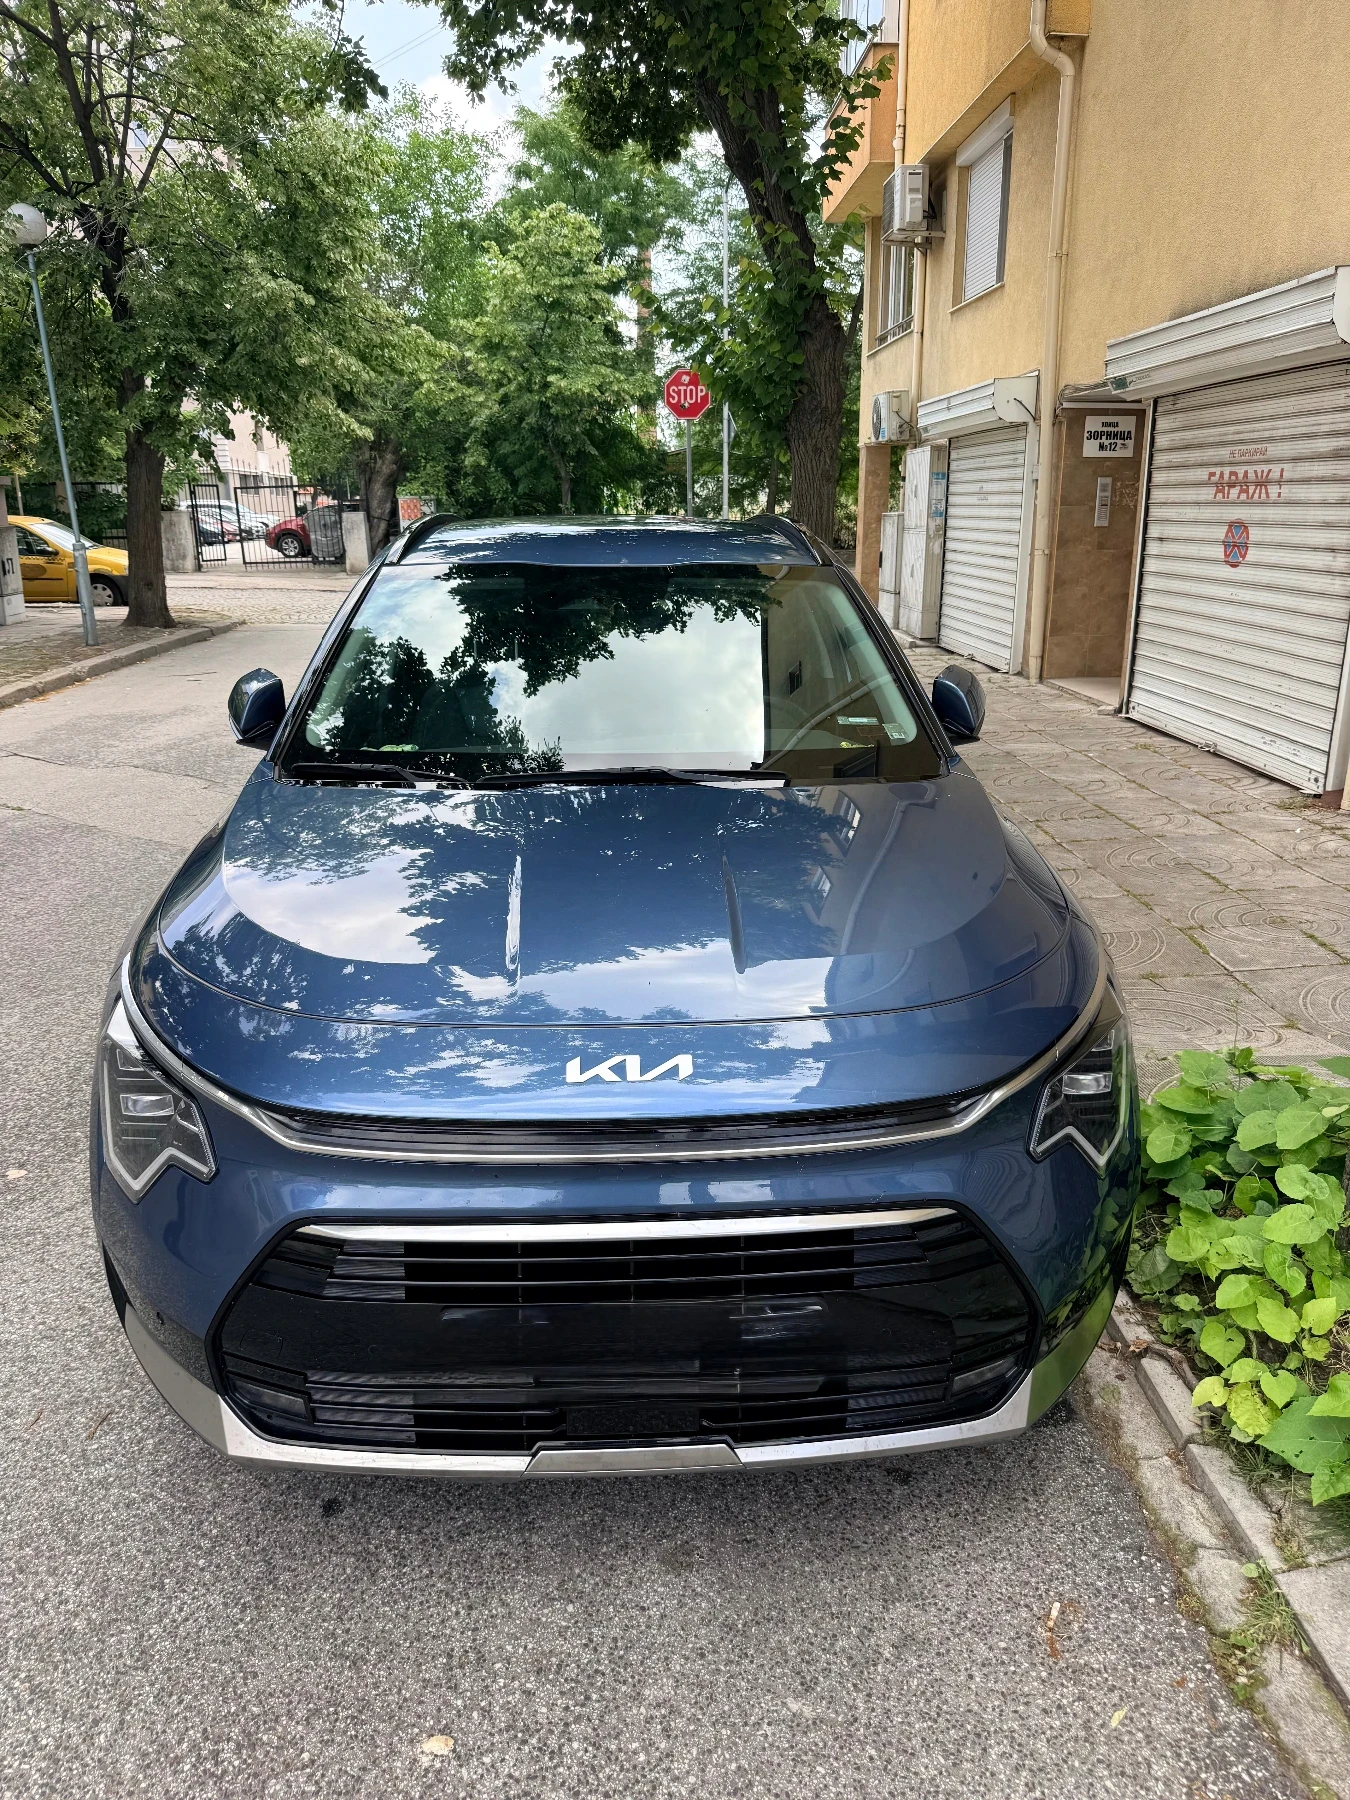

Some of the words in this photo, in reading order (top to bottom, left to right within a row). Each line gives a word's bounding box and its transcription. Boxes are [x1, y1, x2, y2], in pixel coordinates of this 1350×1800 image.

[669, 385, 706, 403] STOP
[1086, 430, 1132, 442] ЗОРНИЦА
[1098, 441, 1118, 452] №12
[1229, 449, 1237, 459] НЕ
[565, 1053, 694, 1083] KIA
